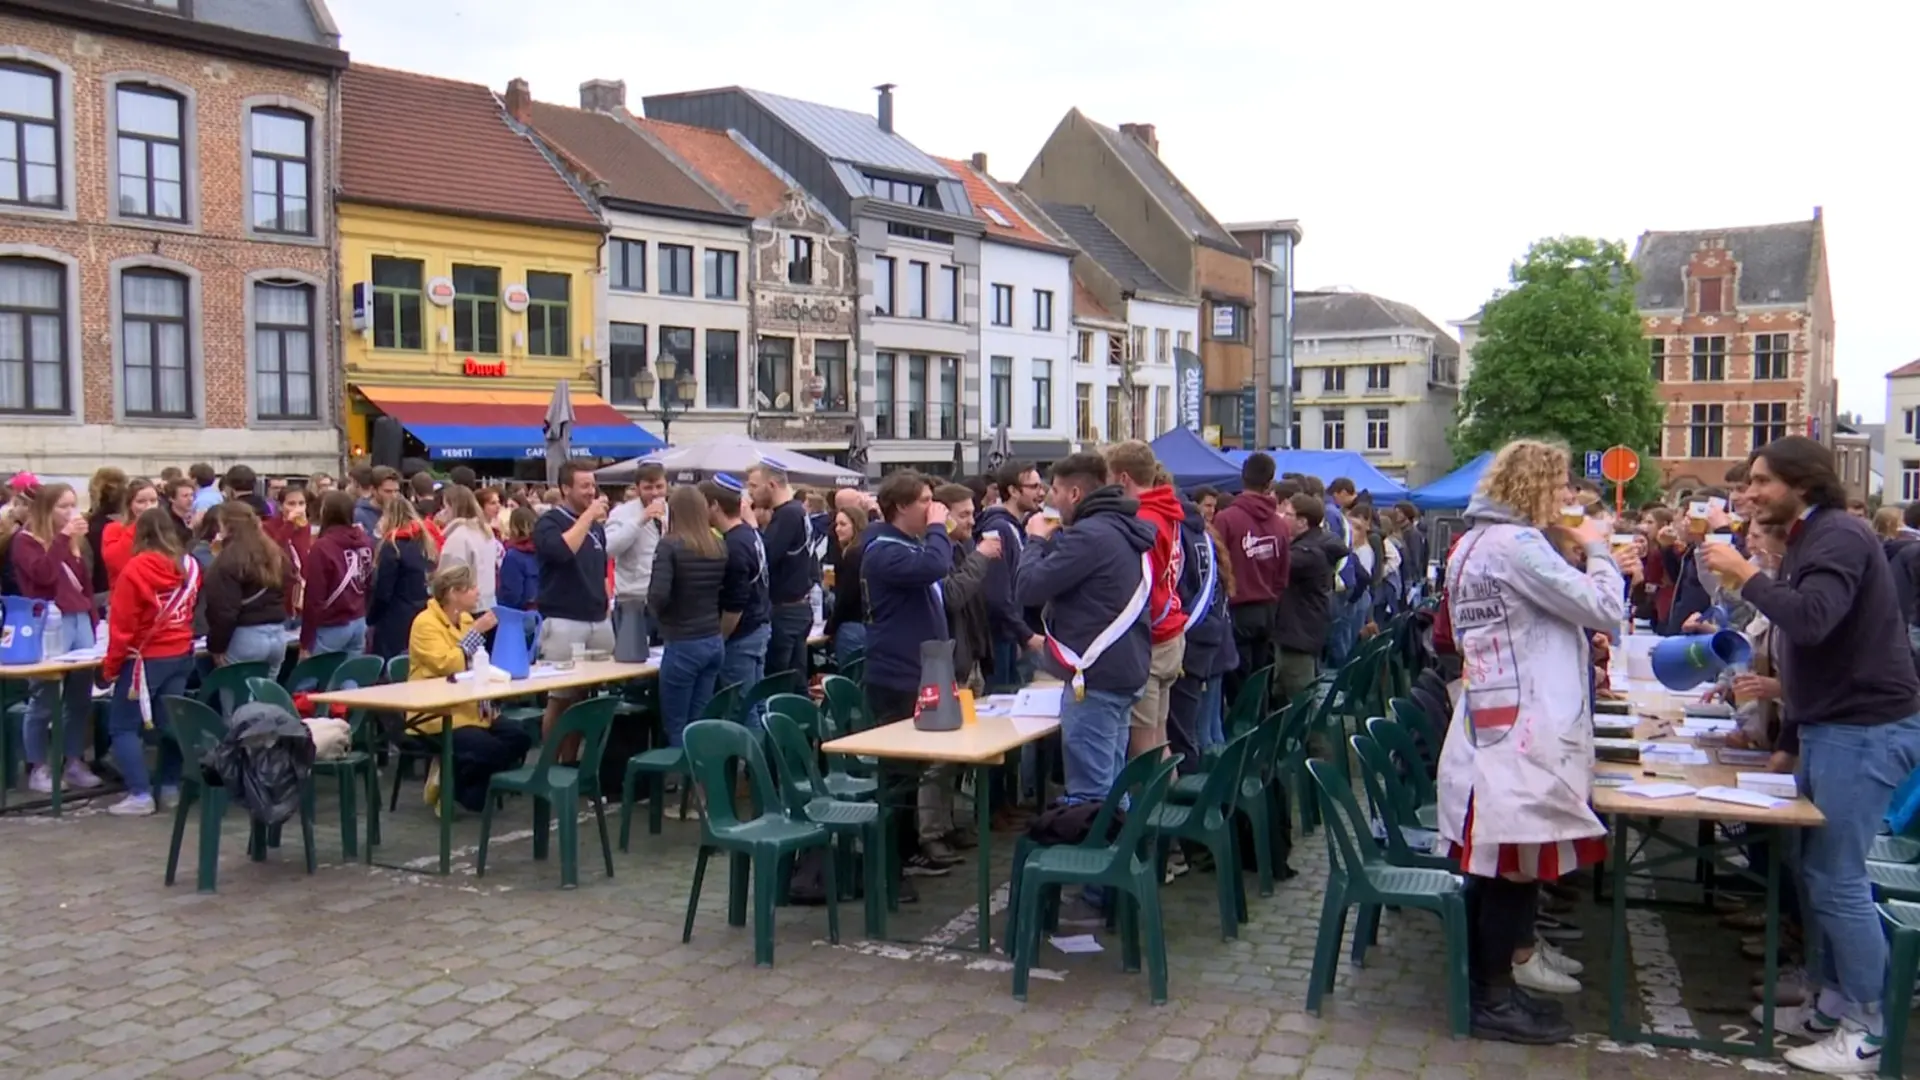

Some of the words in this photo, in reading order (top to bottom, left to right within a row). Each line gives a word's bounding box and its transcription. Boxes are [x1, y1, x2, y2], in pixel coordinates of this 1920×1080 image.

[775, 303, 838, 322] LEOPOLD
[464, 356, 508, 377] Duvel
[1589, 453, 1599, 468] P
